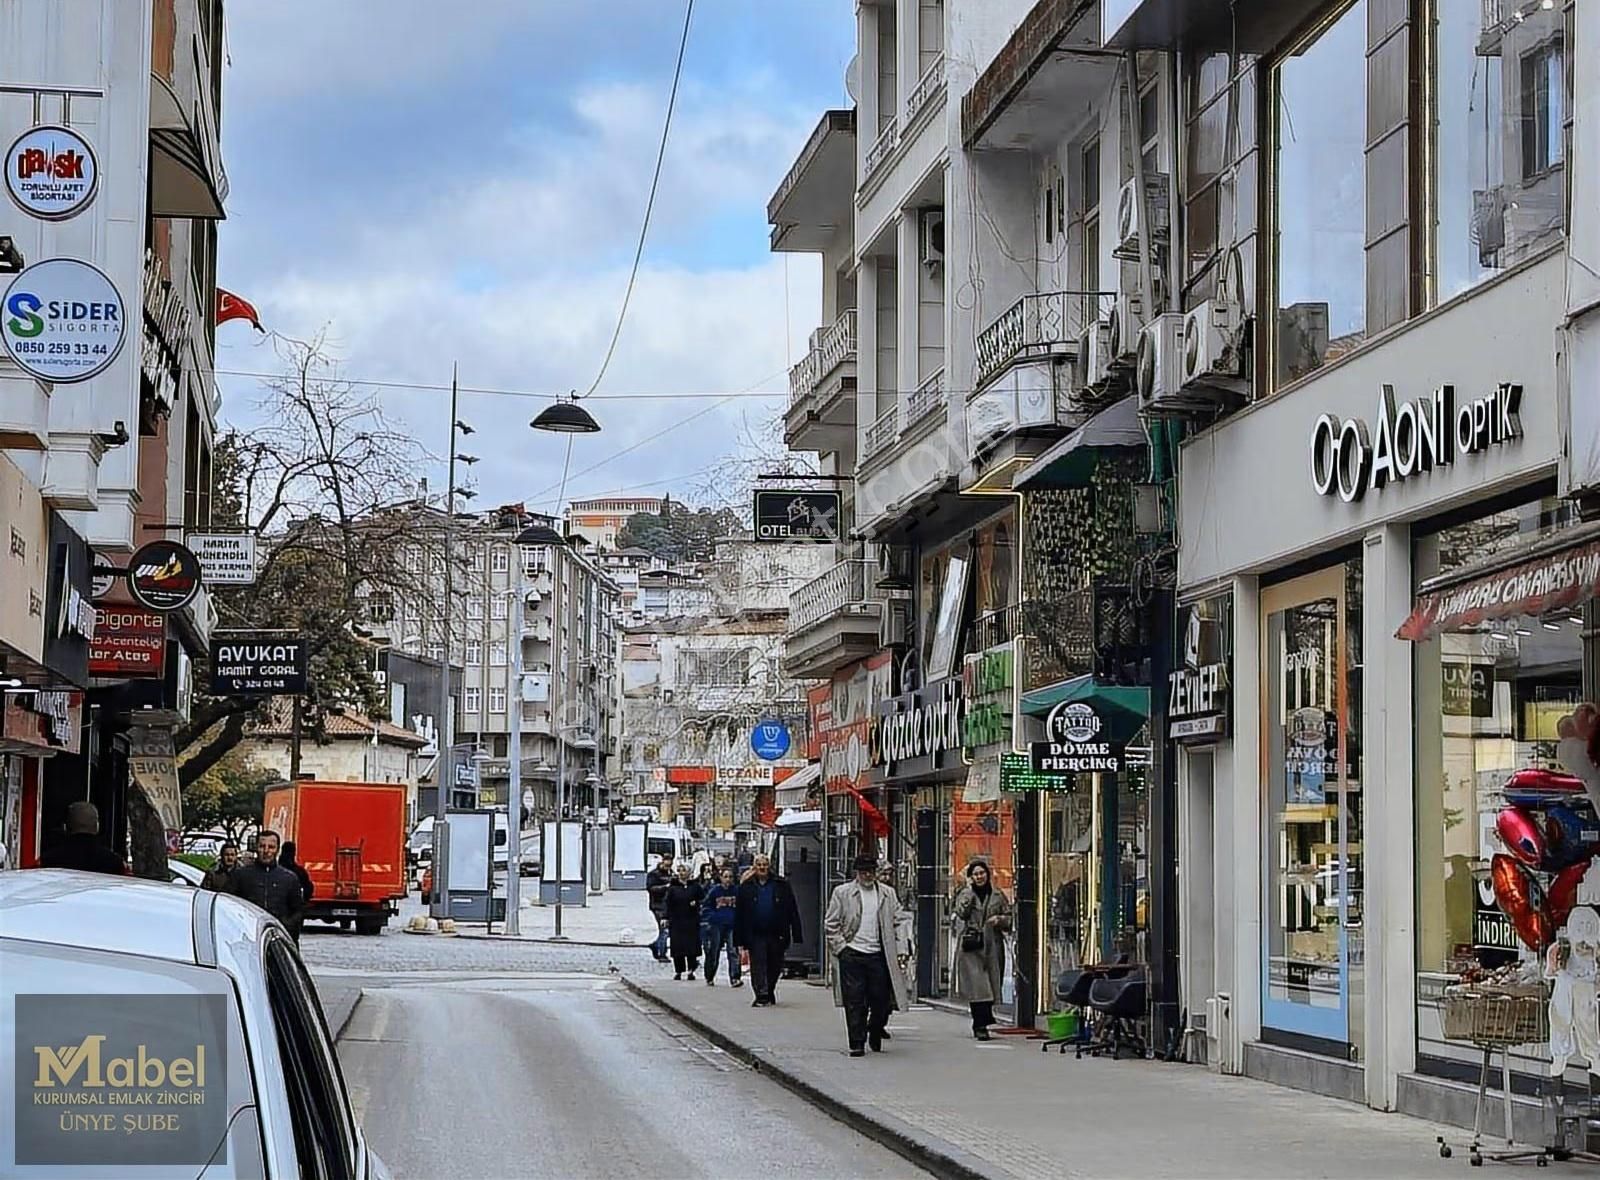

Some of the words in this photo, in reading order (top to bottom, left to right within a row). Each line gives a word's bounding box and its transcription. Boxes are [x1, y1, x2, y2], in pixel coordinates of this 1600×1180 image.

[15, 342, 45, 353] 0850
[48, 343, 71, 354] 259
[74, 344, 89, 354] 33
[92, 344, 107, 354] 44
[760, 525, 794, 536] OTEL
[218, 645, 298, 662] AVUKAT
[1050, 741, 1110, 755] DÖYME
[719, 767, 770, 779] ECZANE
